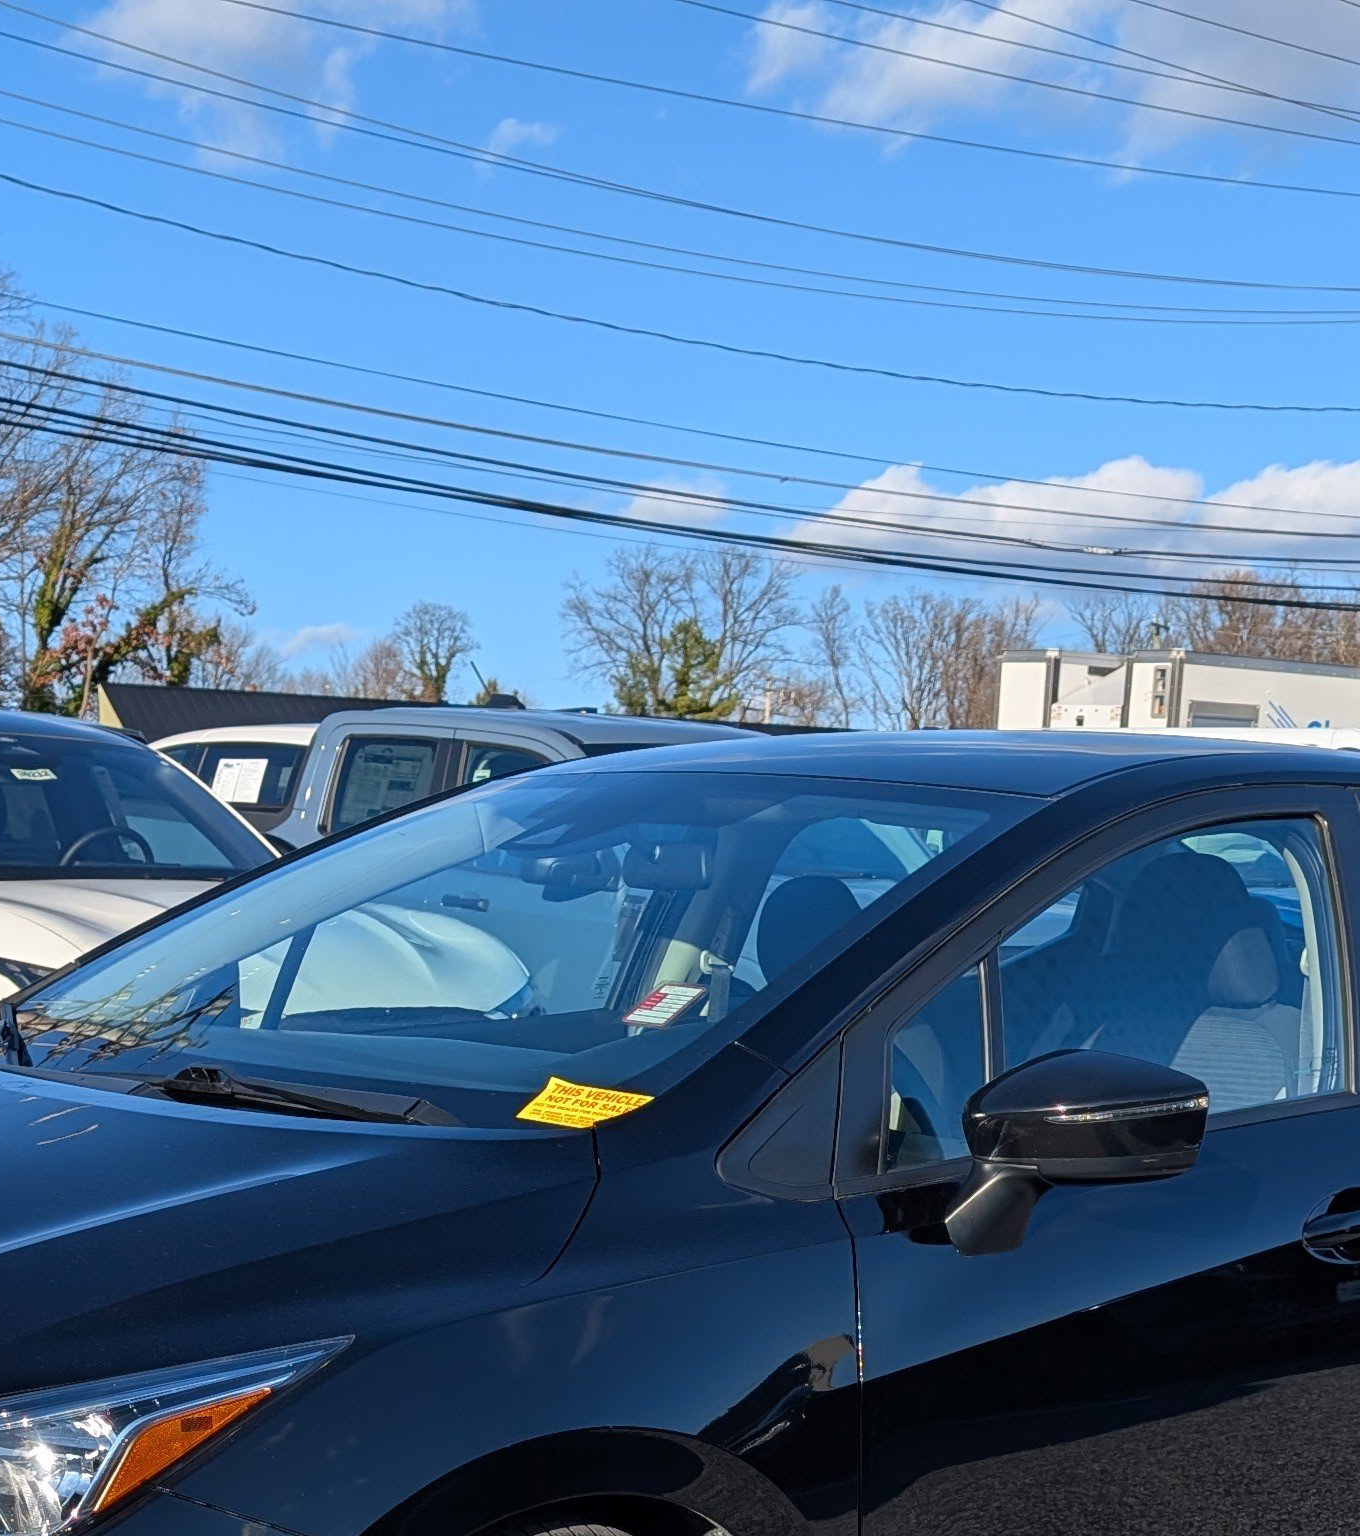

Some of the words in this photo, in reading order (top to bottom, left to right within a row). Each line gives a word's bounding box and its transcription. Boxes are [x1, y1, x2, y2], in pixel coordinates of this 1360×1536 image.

[544, 1094, 570, 1105] NOT
[571, 1098, 599, 1109] FOR
[551, 1083, 584, 1097] THIS
[585, 1089, 647, 1107] VEHICLE
